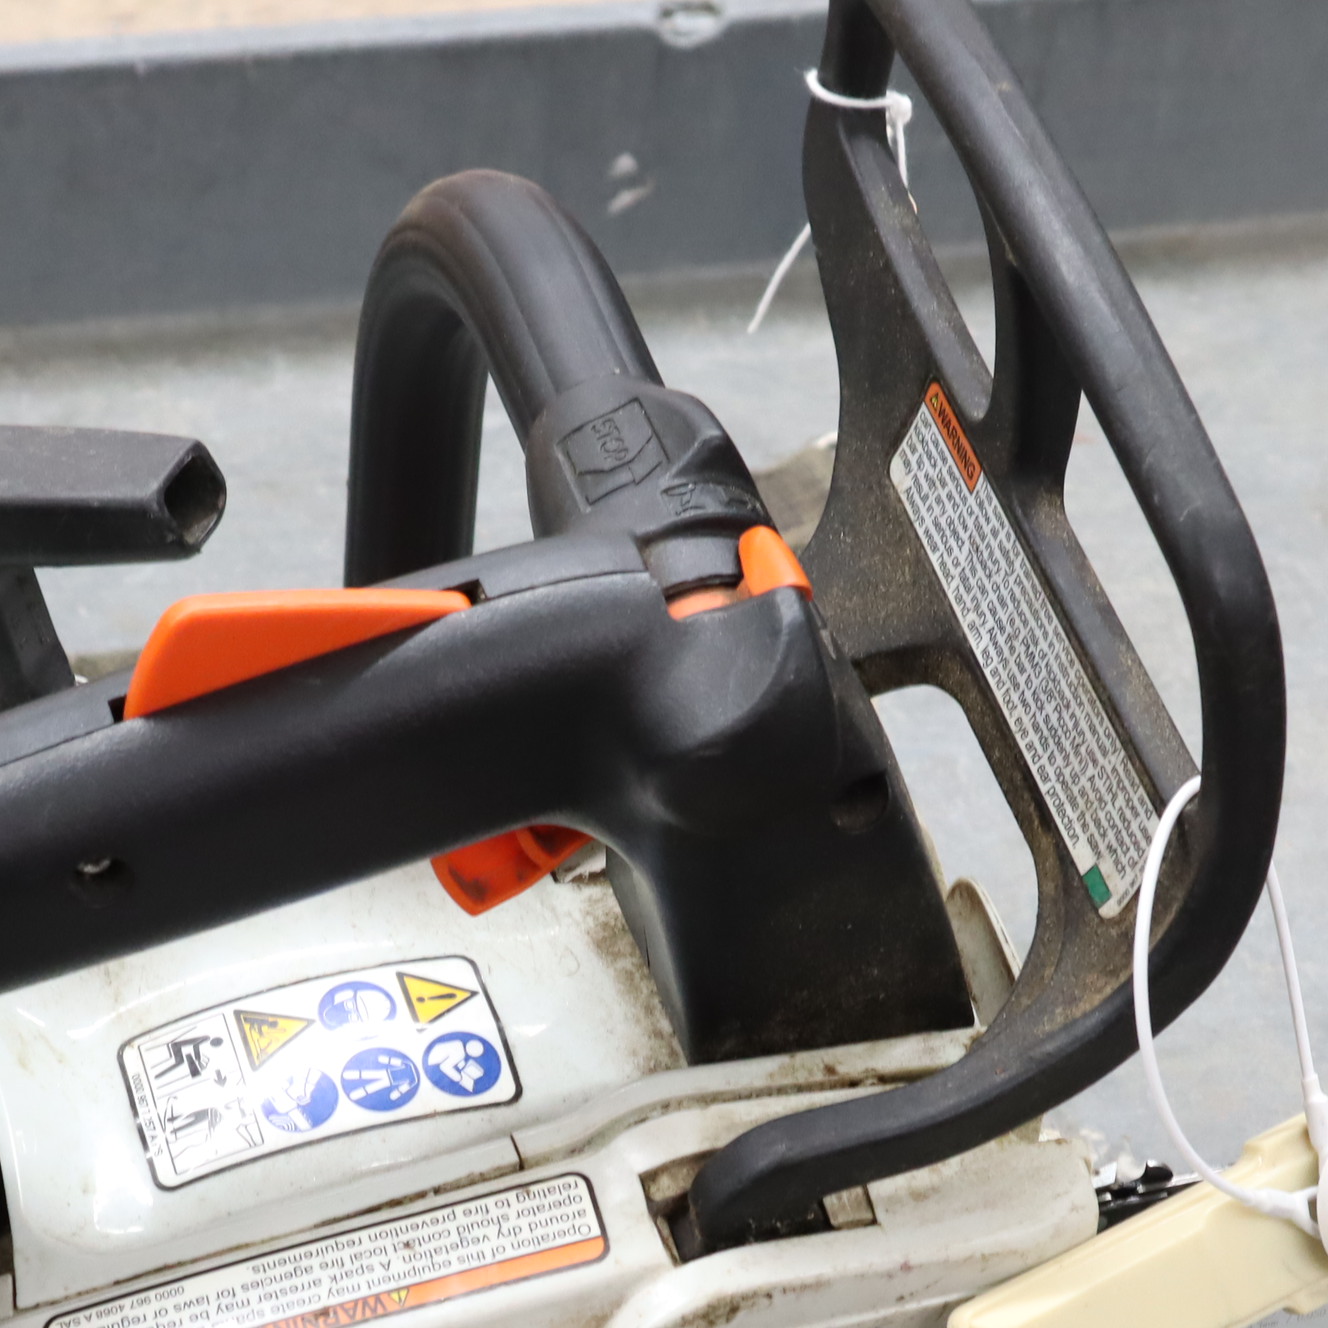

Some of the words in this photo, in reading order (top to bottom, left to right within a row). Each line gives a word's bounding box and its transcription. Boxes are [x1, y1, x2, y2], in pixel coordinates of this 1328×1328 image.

[934, 401, 978, 482] WARNING
[897, 447, 913, 479] may
[910, 470, 930, 508] result
[925, 501, 935, 519] in
[930, 512, 955, 559] serious
[950, 555, 960, 573] or
[957, 567, 974, 598] fatal
[918, 410, 931, 435] can
[928, 430, 948, 468] cause
[1095, 764, 1121, 810] STIHL
[901, 482, 927, 533] Always
[921, 524, 939, 560] wear
[978, 642, 995, 673] leg
[988, 661, 1007, 694] and
[1011, 714, 1029, 745] eye
[1024, 734, 1043, 767] and
[1036, 761, 1051, 788] ear
[935, 466, 949, 492] bar
[945, 486, 960, 515] and
[989, 578, 1011, 616] chain
[1018, 636, 1043, 681] PMM3
[1085, 772, 1108, 812] Avoid
[905, 433, 919, 459] bar
[932, 492, 947, 521] any
[962, 549, 979, 580] This
[974, 576, 989, 602] can
[985, 599, 1006, 638] cause
[1003, 632, 1018, 658] the
[1012, 652, 1028, 679] bar
[1023, 673, 1034, 692] to
[1029, 686, 1046, 716] kick
[1039, 710, 1073, 772] suddenly
[1066, 767, 1080, 791] up
[1076, 782, 1094, 813] and
[1089, 808, 1110, 844] back
[1103, 838, 1128, 881] which
[983, 624, 1010, 674] Always
[1005, 668, 1020, 695] use
[1016, 689, 1032, 717] two
[1027, 712, 1051, 754] hands
[1046, 750, 1057, 769] to
[1050, 763, 1080, 817] operate
[1117, 755, 1141, 795] Read
[1136, 790, 1155, 822] and
[1075, 810, 1091, 836] the
[1136, 819, 1153, 847] use
[514, 1175, 579, 1206] relating
[461, 1202, 490, 1220] fire
[493, 1197, 511, 1212] to
[512, 1189, 584, 1222] operator
[366, 1207, 457, 1246] prevention
[455, 1212, 511, 1237] should
[494, 1221, 523, 1242] dry
[526, 1206, 588, 1234] around
[391, 1227, 452, 1254] contact
[508, 1217, 593, 1255] Operation
[244, 1232, 363, 1278] requirements.
[348, 1244, 388, 1265] local
[456, 1248, 487, 1267] this
[489, 1243, 507, 1258] of
[238, 1261, 315, 1295] agencies
[318, 1256, 345, 1273] fire
[326, 1259, 376, 1286] spark
[364, 1253, 453, 1292] equipment
[378, 1258, 393, 1272] A
[128, 1294, 151, 1310] 967
[152, 1284, 185, 1302] 0000
[213, 1286, 237, 1303] for
[255, 1276, 323, 1305] arrester
[324, 1278, 361, 1299] may
[150, 1305, 168, 1319] or
[171, 1294, 210, 1315] laws
[187, 1309, 210, 1325] be
[213, 1293, 251, 1315] may
[269, 1292, 322, 1317] create
[82, 1312, 93, 1324] A
